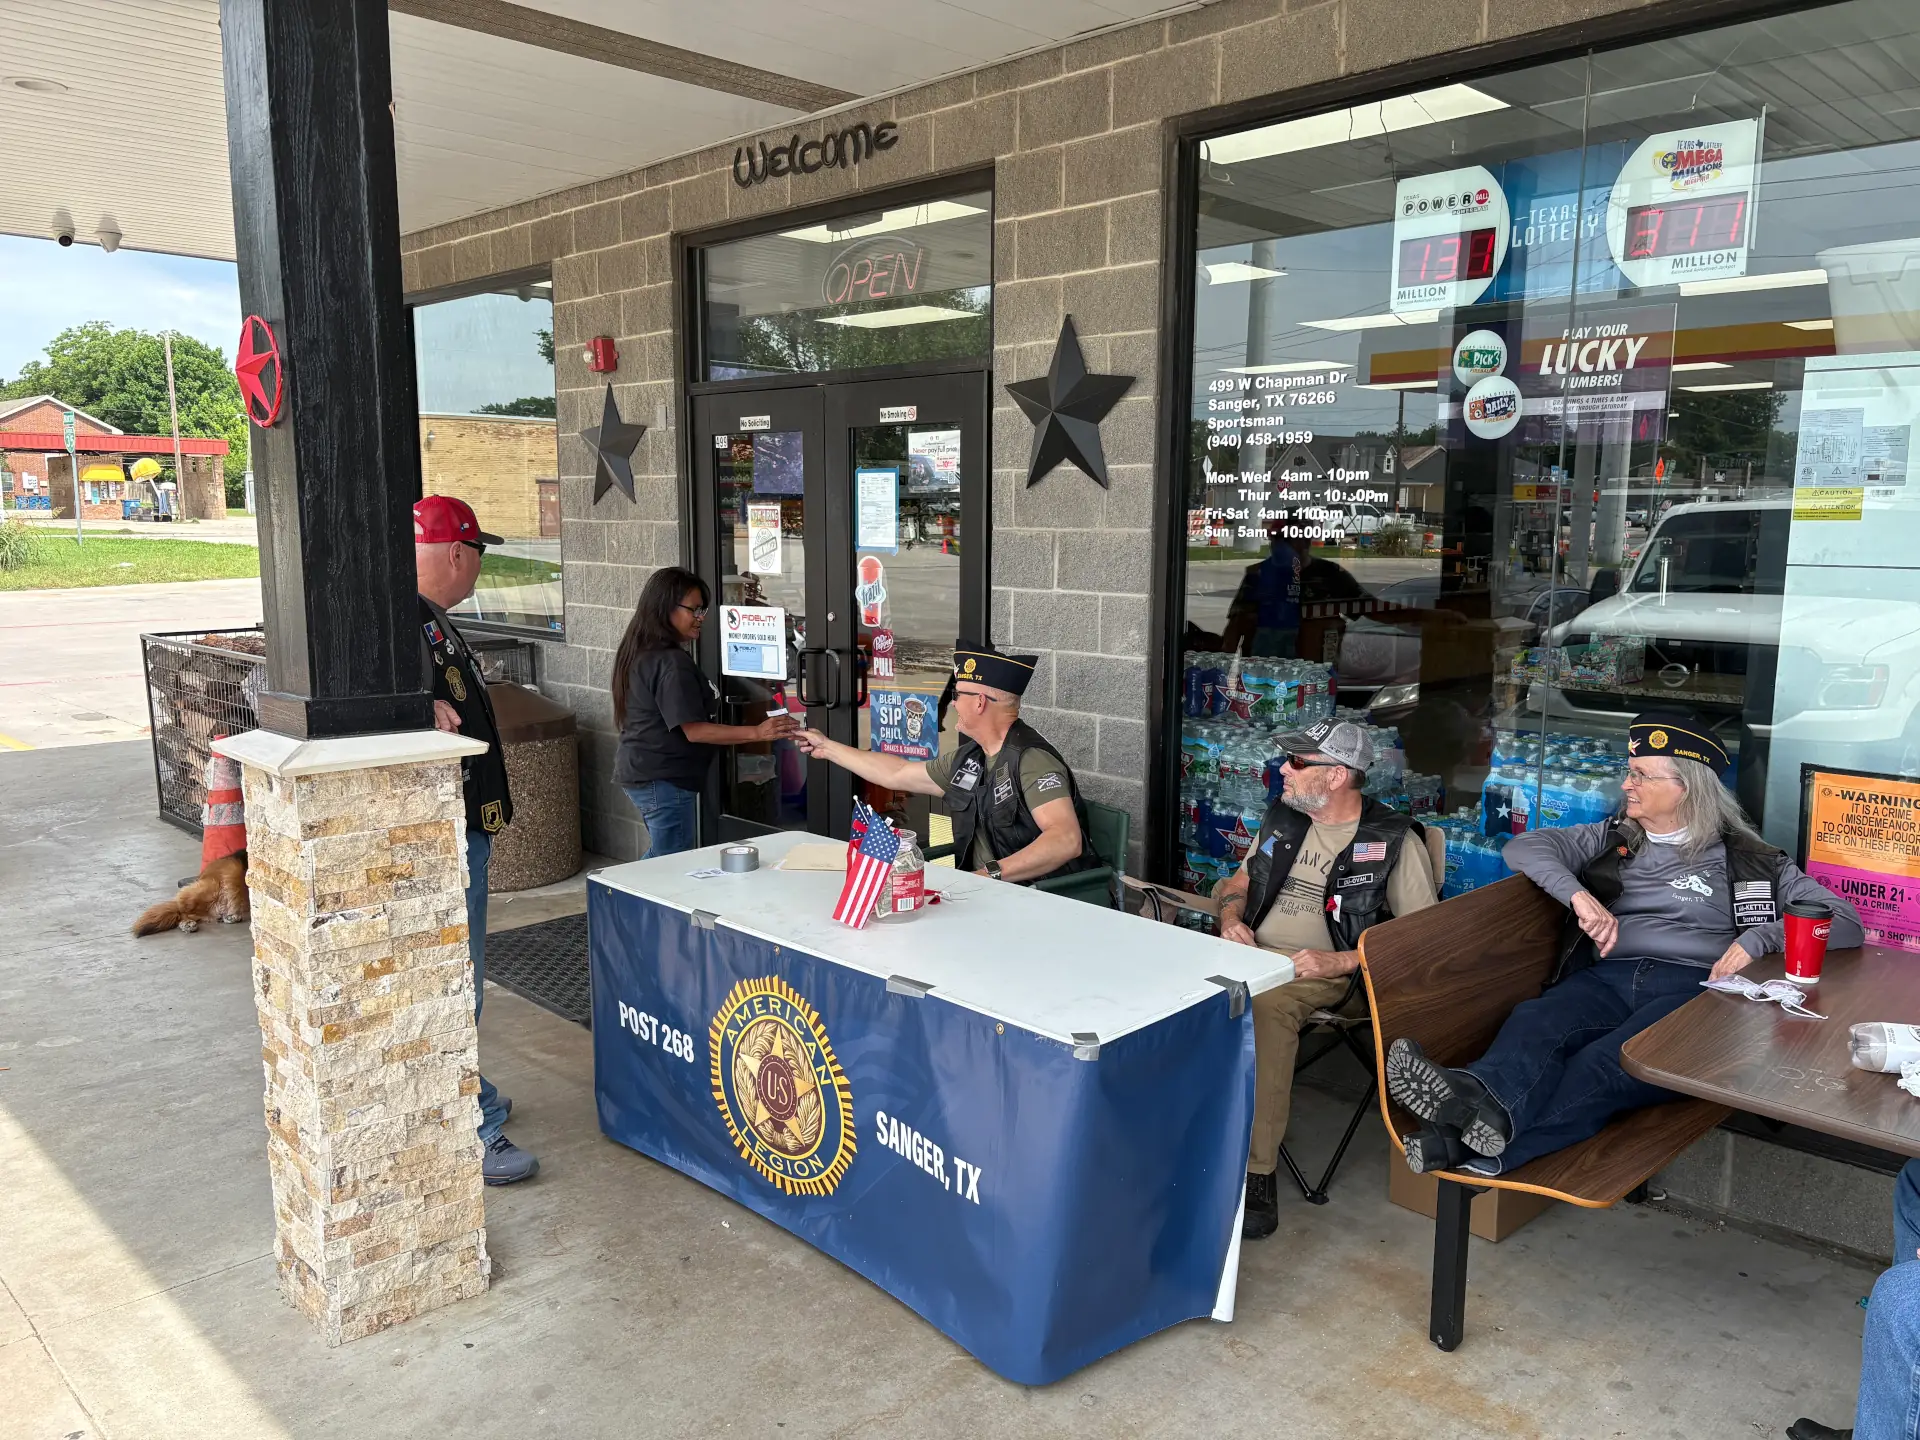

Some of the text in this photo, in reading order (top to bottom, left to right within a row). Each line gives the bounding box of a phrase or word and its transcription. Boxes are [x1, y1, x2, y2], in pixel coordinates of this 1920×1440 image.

[1672, 149, 1722, 170] MEGA
[1670, 162, 1722, 182] MILLIONS
[1404, 193, 1472, 215] POWER
[1530, 203, 1578, 224] TEXAS
[1631, 199, 1744, 257] 311
[1421, 234, 1494, 281] 131
[1672, 252, 1737, 270] MILLION
[826, 248, 923, 304] OPEN
[1397, 286, 1446, 300] MILLION
[1562, 324, 1628, 340] PLAY YOUR
[1473, 351, 1500, 366] PICK 3
[1540, 336, 1648, 376] LUCKY
[1208, 372, 1348, 392] 499 W Chapman Dr
[1208, 391, 1336, 412] Sanger, TX 76266
[1486, 398, 1509, 414] DAILY
[740, 417, 770, 428] No Soliciting
[880, 408, 907, 420] No Smoking
[1207, 415, 1284, 432] Sportsman
[716, 436, 728, 448] 499
[1206, 430, 1313, 450] (940) 458-1959
[946, 446, 958, 454] price
[1206, 472, 1238, 484] Mon-
[1241, 470, 1272, 484] Wed
[1280, 470, 1312, 482] 4am
[1327, 468, 1370, 483] 10pm
[1238, 488, 1272, 501] Thur
[1279, 488, 1310, 500] 4am
[1204, 508, 1250, 520] Fri-Sat
[1258, 506, 1288, 520] 4am
[1204, 526, 1230, 538] Sun
[1238, 526, 1267, 538] 5am
[1281, 525, 1344, 541] 10:00pm
[876, 637, 892, 650] Pepper
[874, 657, 894, 676] PULL
[880, 694, 902, 706] BLEND
[880, 706, 902, 726] SIP
[880, 726, 902, 740] CHILL
[884, 744, 900, 752] SHAKES
[904, 746, 926, 756] SMOOTHIES
[1674, 748, 1710, 764] SANGER, TX
[1512, 814, 1526, 824] TEXAS
[1852, 803, 1912, 820] IT IS A CRIME
[1822, 821, 1834, 832] TO
[1837, 824, 1884, 840] CONSUME
[1846, 814, 1916, 832] MISDEMEANOR
[1816, 832, 1840, 844] BEER
[1844, 836, 1857, 848] ON
[1860, 838, 1890, 852] THESE
[1672, 892, 1692, 902] Sanger,
[1842, 878, 1886, 900] UNDER
[1890, 887, 1904, 902] 21
[1280, 906, 1299, 916] SHOW
[1288, 900, 1316, 914] CLASSIC
[1845, 896, 1900, 912] IT'S A CRIME:
[1874, 928, 1884, 938] TO
[1888, 931, 1912, 942] SHOW
[618, 1000, 694, 1063] POST 268
[726, 997, 831, 1087] AMERICAN
[741, 1126, 825, 1177] LEGION
[876, 1111, 982, 1205] SANGER, TX
